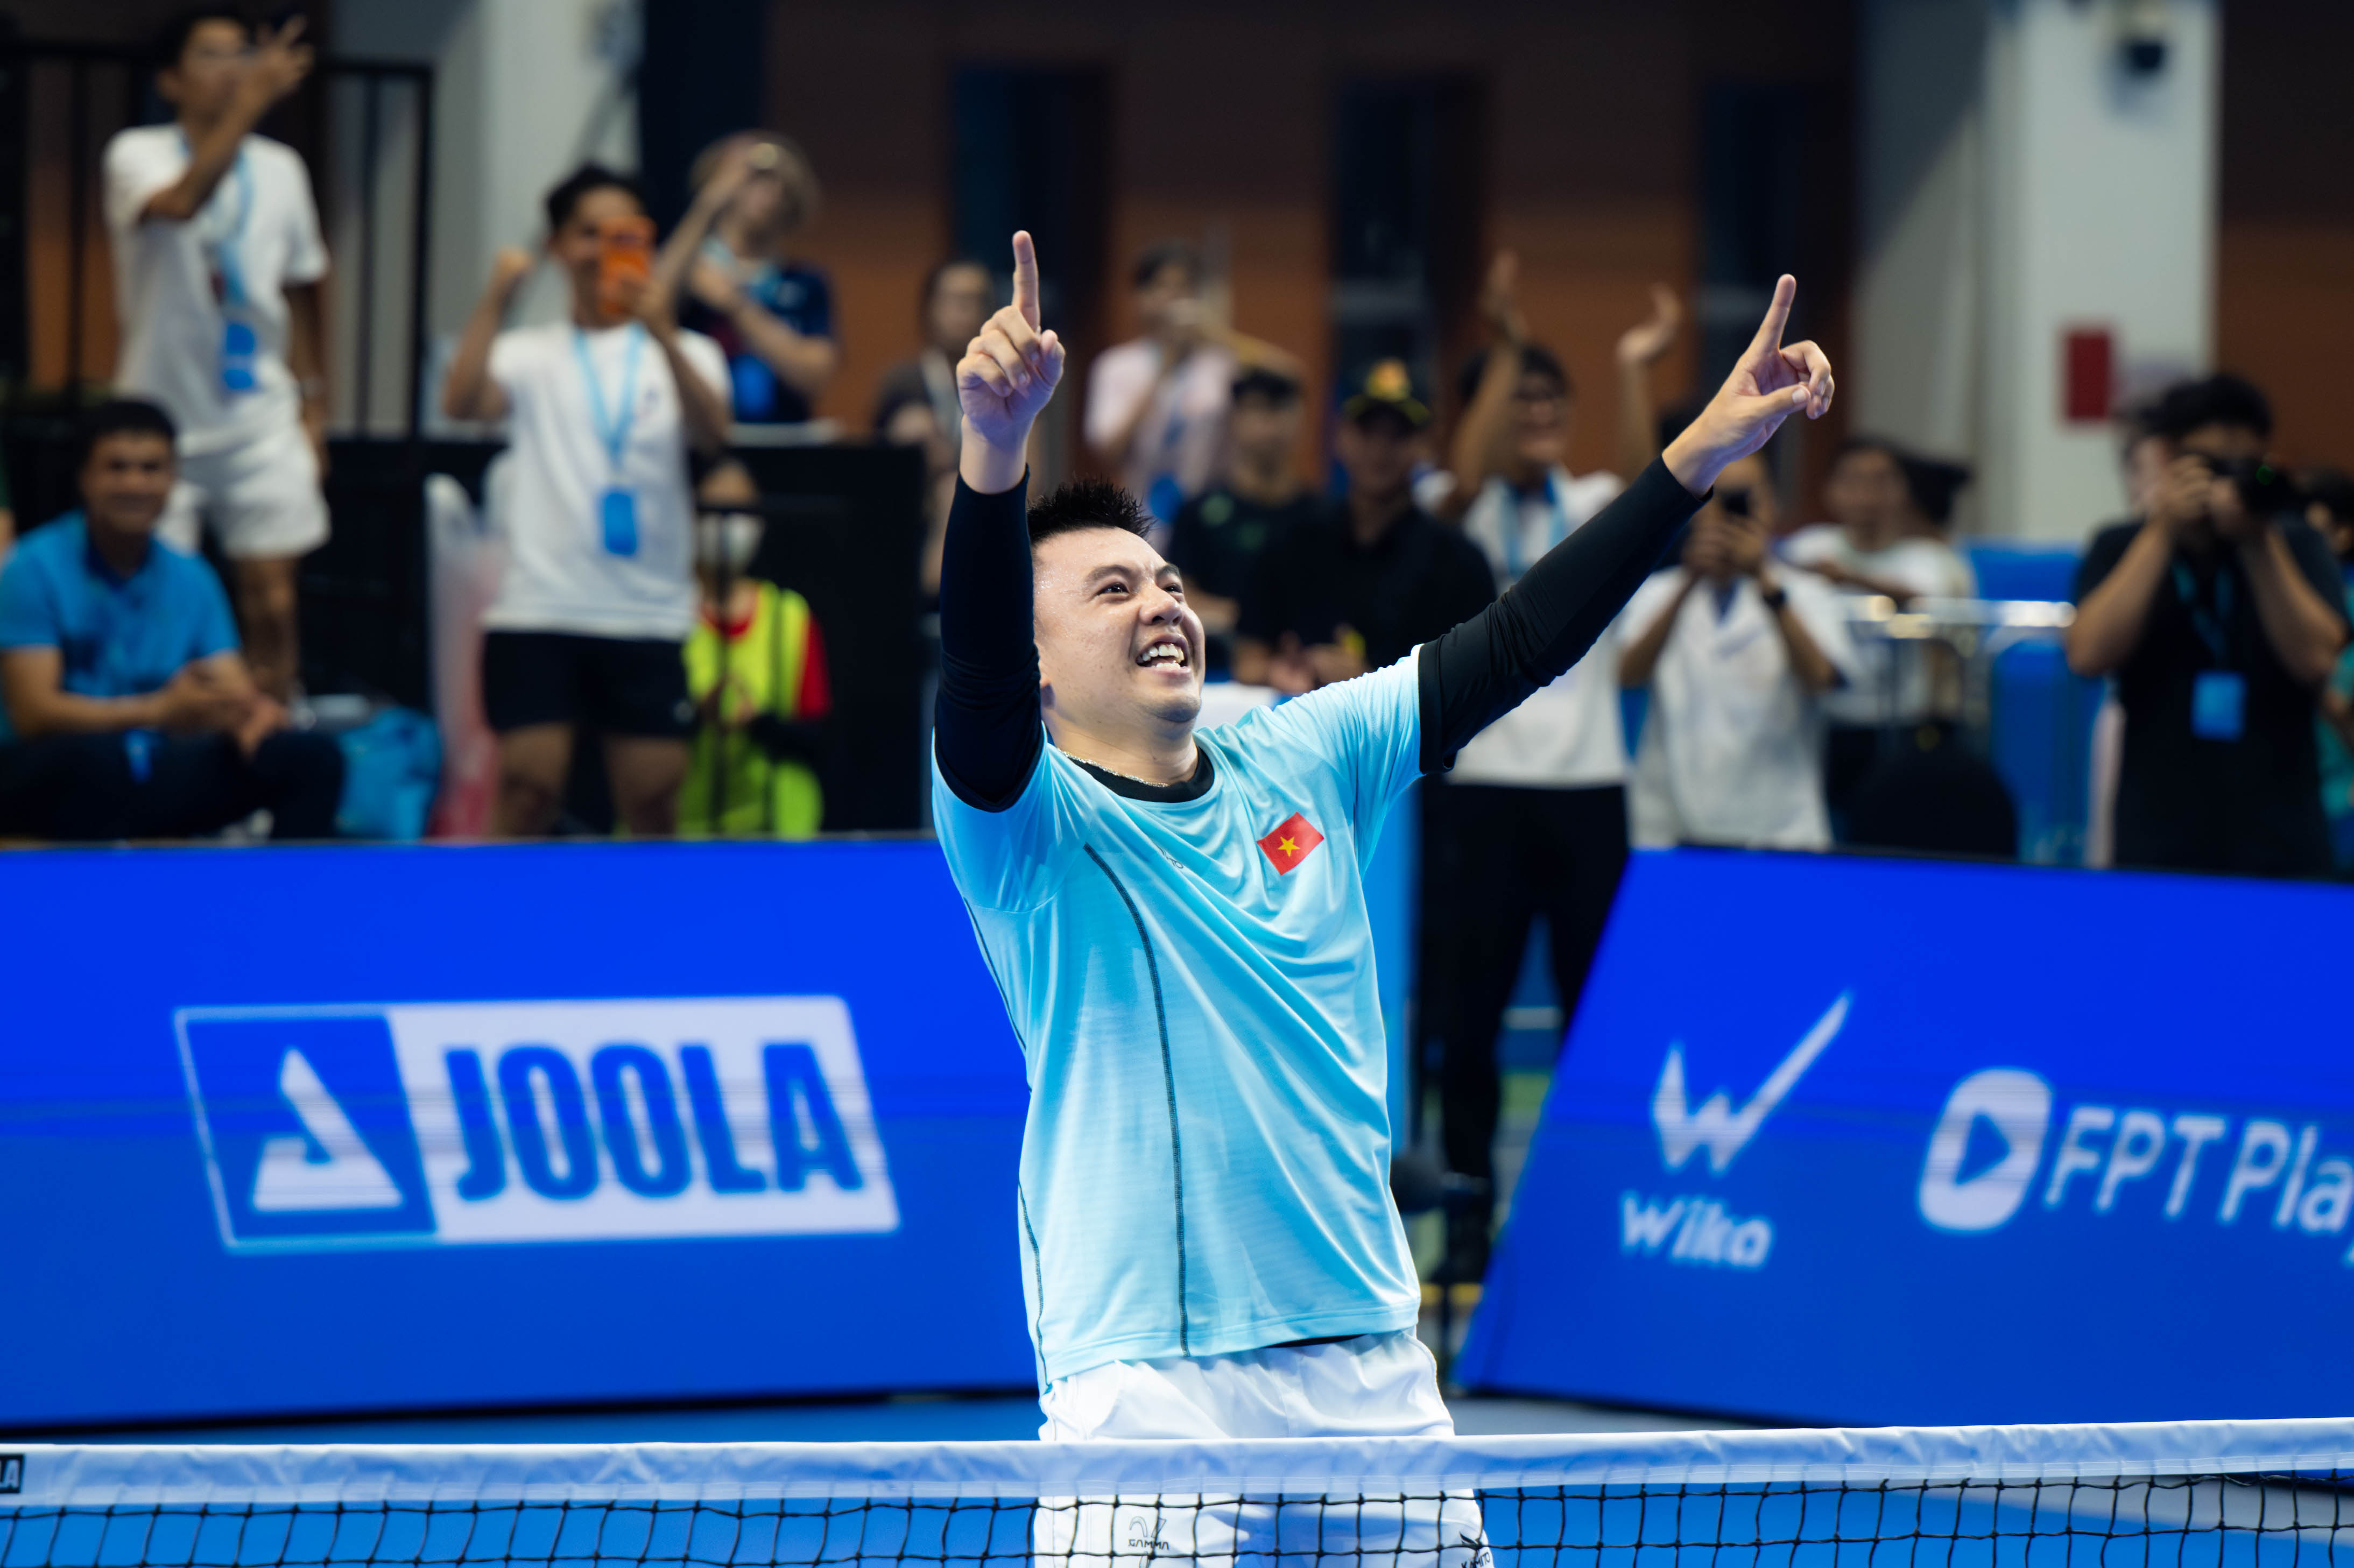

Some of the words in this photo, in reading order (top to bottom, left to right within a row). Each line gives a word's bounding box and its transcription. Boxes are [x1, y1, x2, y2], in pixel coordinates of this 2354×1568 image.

[445, 1042, 865, 1202] JOOLA
[2046, 1105, 2227, 1219] FPT
[2218, 1117, 2354, 1263] Pla
